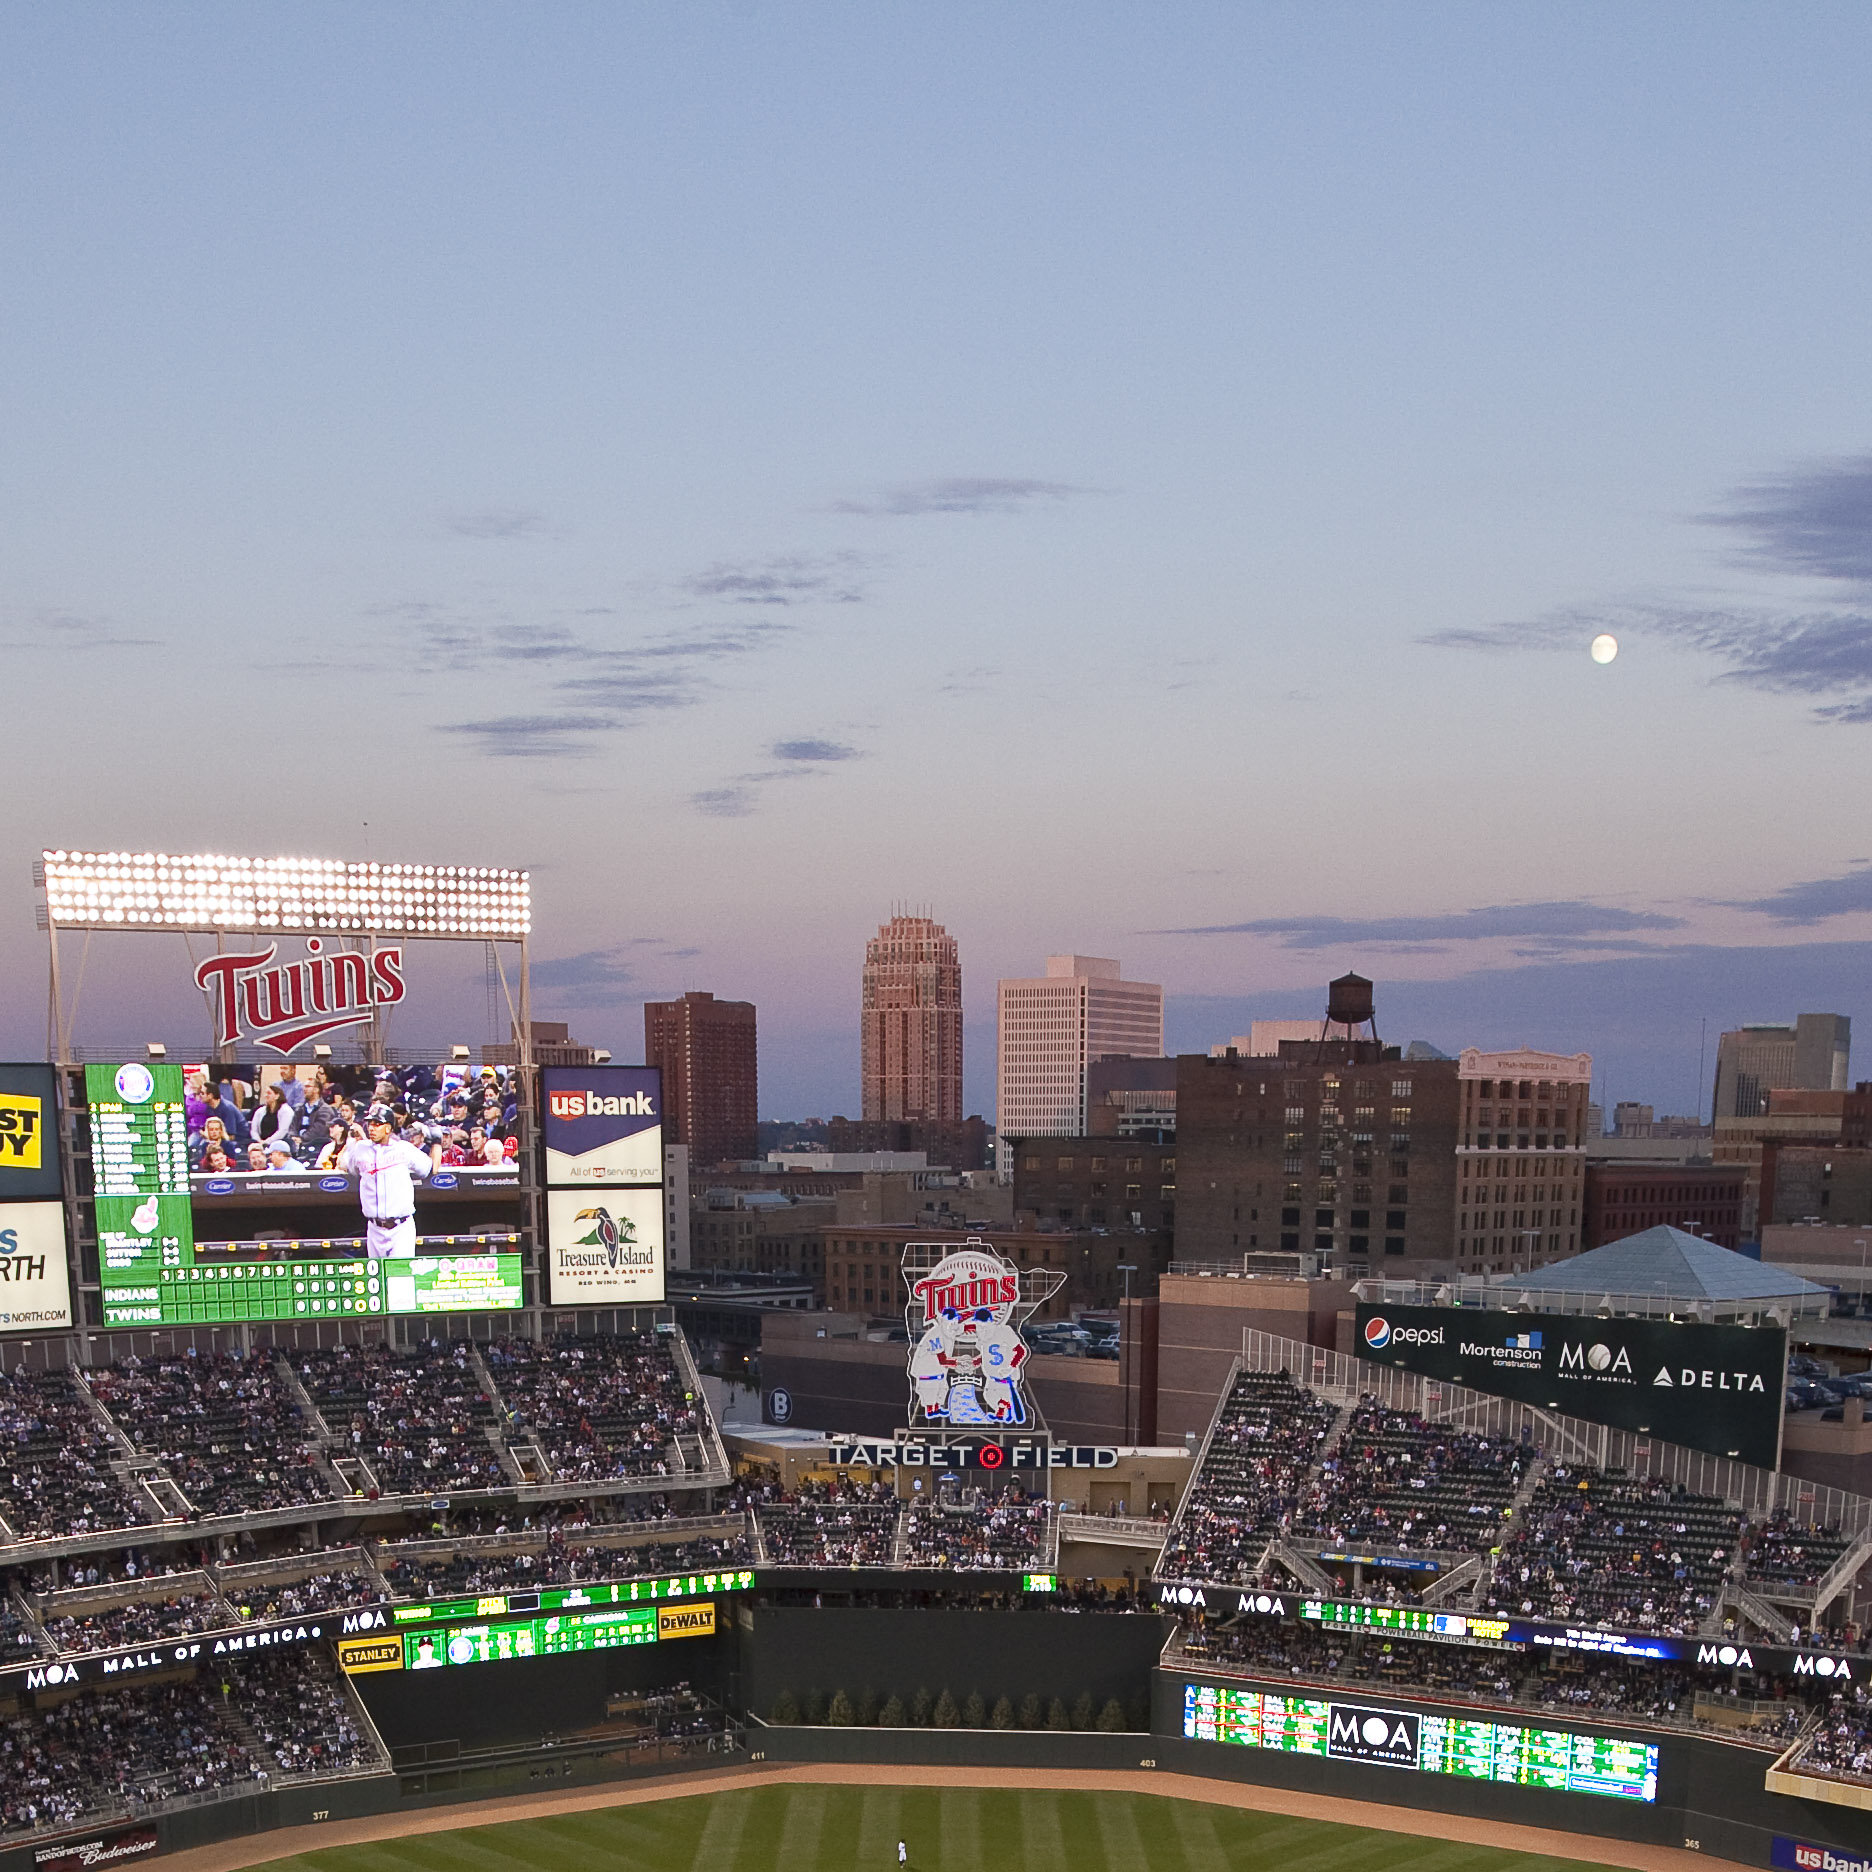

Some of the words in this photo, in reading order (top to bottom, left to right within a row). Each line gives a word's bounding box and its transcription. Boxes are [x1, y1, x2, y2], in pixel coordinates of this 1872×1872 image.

[194, 937, 407, 1056] Twins
[557, 1249, 606, 1267] Treasure
[619, 1246, 653, 1265] Island
[105, 1288, 158, 1301] INDIANS
[915, 1272, 1016, 1321] Twins
[106, 1308, 161, 1321] TWINS
[928, 1338, 942, 1351] M
[1393, 1327, 1444, 1346] pepsi
[989, 1344, 1004, 1365] S
[1460, 1343, 1542, 1360] Mortenson
[1493, 1360, 1541, 1369] construction
[1597, 1376, 1631, 1384] AMERICA
[1681, 1369, 1764, 1392] DELTA
[832, 1444, 971, 1469] TARGET
[1012, 1446, 1118, 1469] FIELD
[1161, 1586, 1206, 1607] MOA
[1239, 1594, 1285, 1616] MOA
[342, 1611, 386, 1634] MOA
[1467, 1619, 1509, 1631] DIAMOND
[1377, 1628, 1427, 1641] POWERBALL
[1429, 1632, 1469, 1644] PAVILION
[1473, 1628, 1503, 1639] NOTES
[26, 1663, 80, 1690] MOA
[103, 1650, 162, 1673] MALL
[175, 1645, 201, 1660] OF
[214, 1627, 308, 1654] AMERICA
[346, 1648, 396, 1663] STANLEY
[1697, 1644, 1753, 1669] MOA
[1793, 1654, 1851, 1680] MOA
[1331, 1712, 1412, 1751] MOA
[1331, 1745, 1353, 1753] MALL
[1373, 1750, 1411, 1761] AMERICA
[79, 1840, 157, 1866] Budweiser
